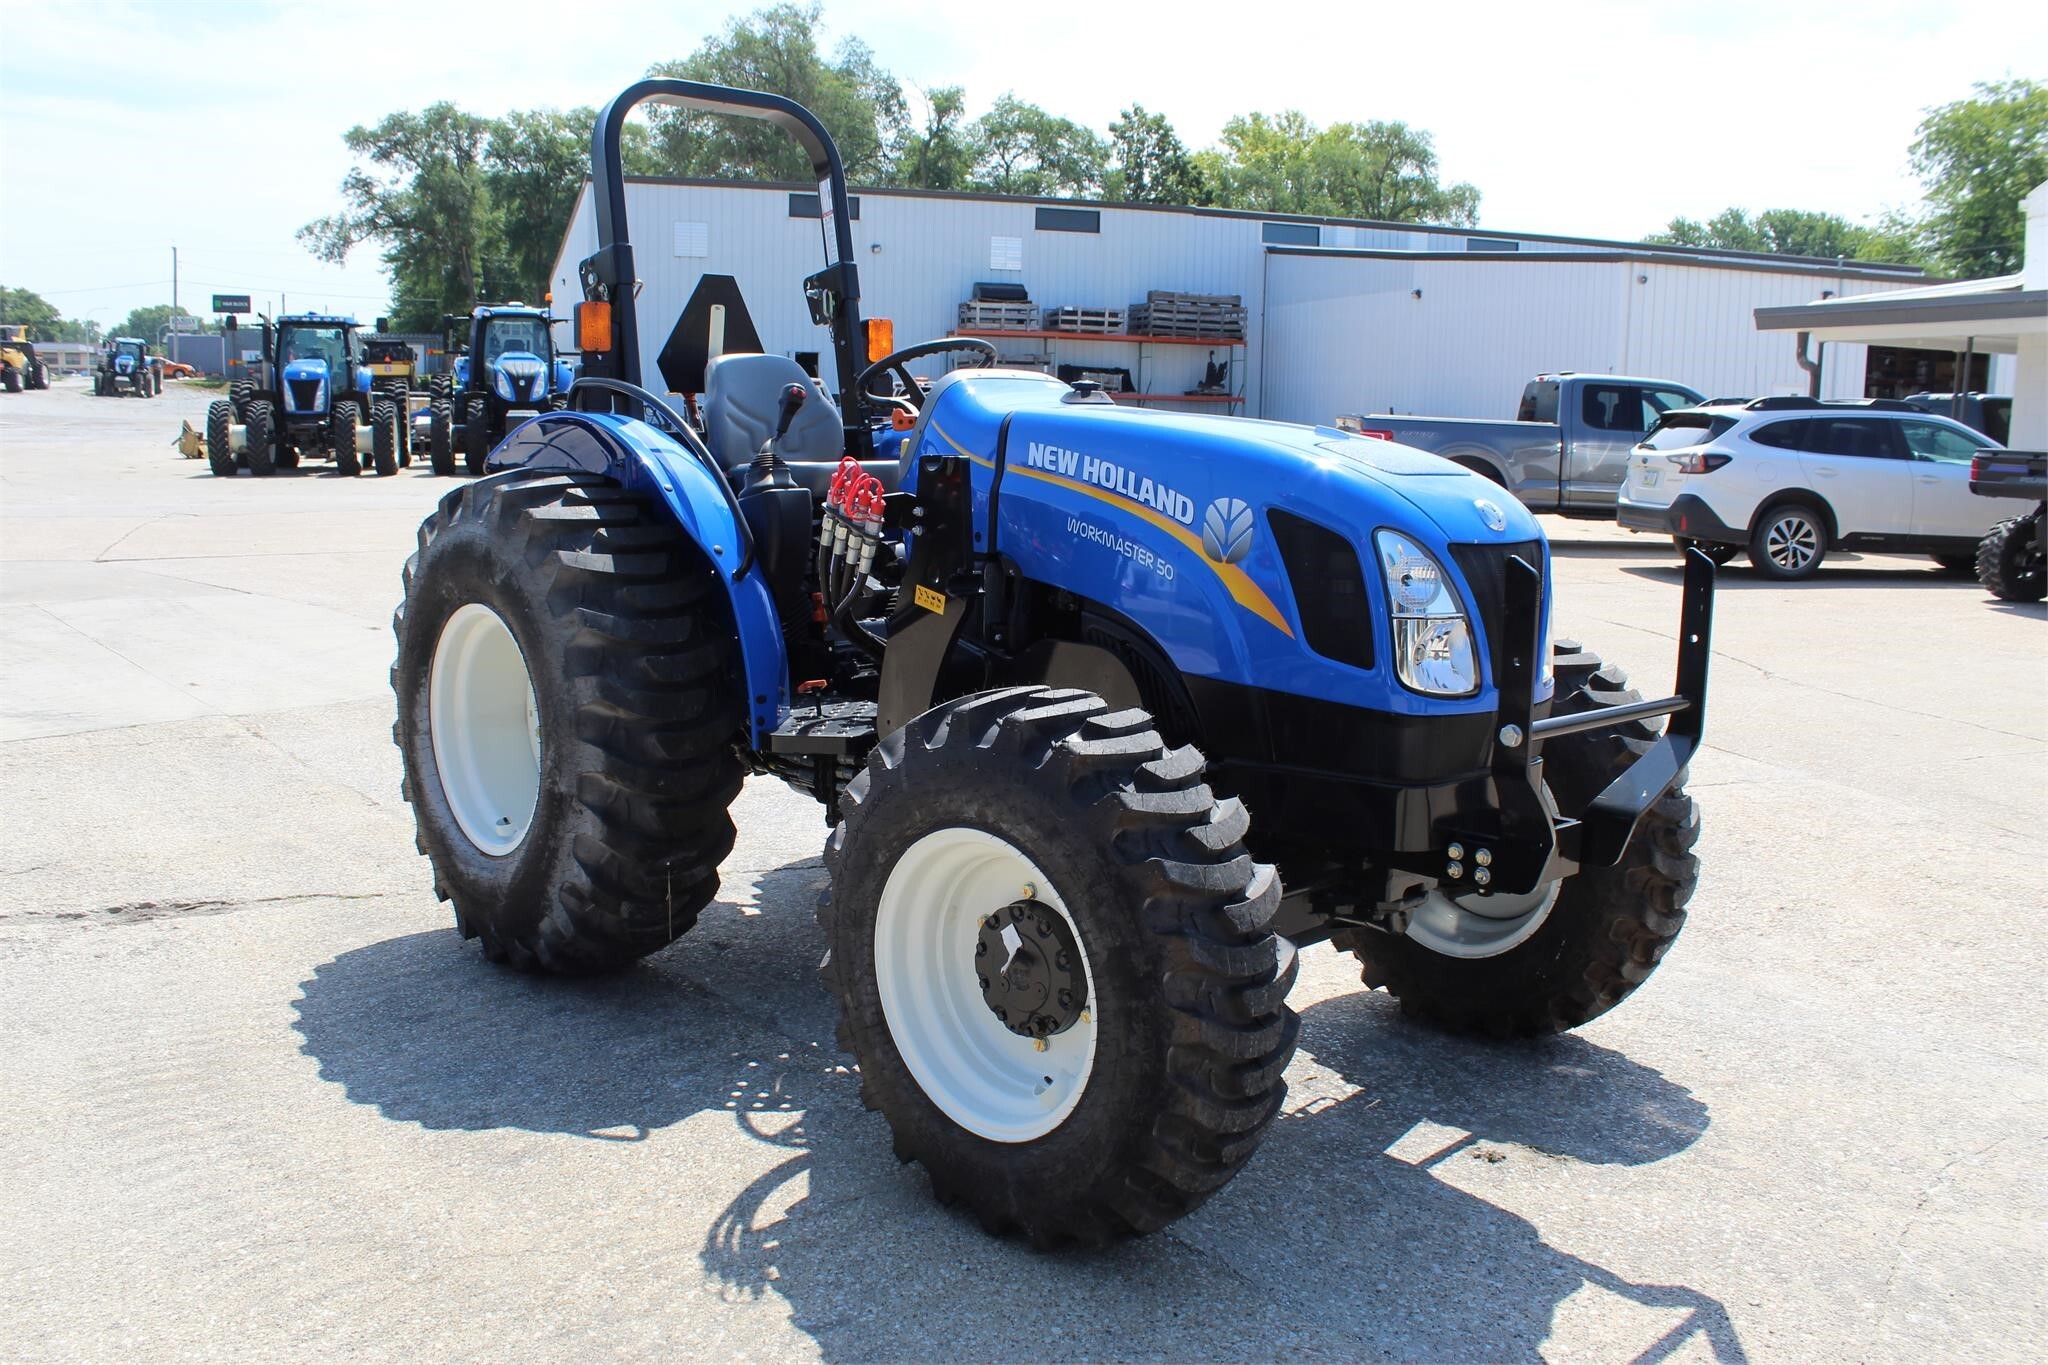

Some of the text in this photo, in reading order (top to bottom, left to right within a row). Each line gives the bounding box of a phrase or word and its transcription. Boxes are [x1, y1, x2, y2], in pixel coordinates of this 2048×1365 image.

[1028, 442, 1195, 526] NEW HOLLAND
[1067, 516, 1174, 581] WORKMASTER 50
